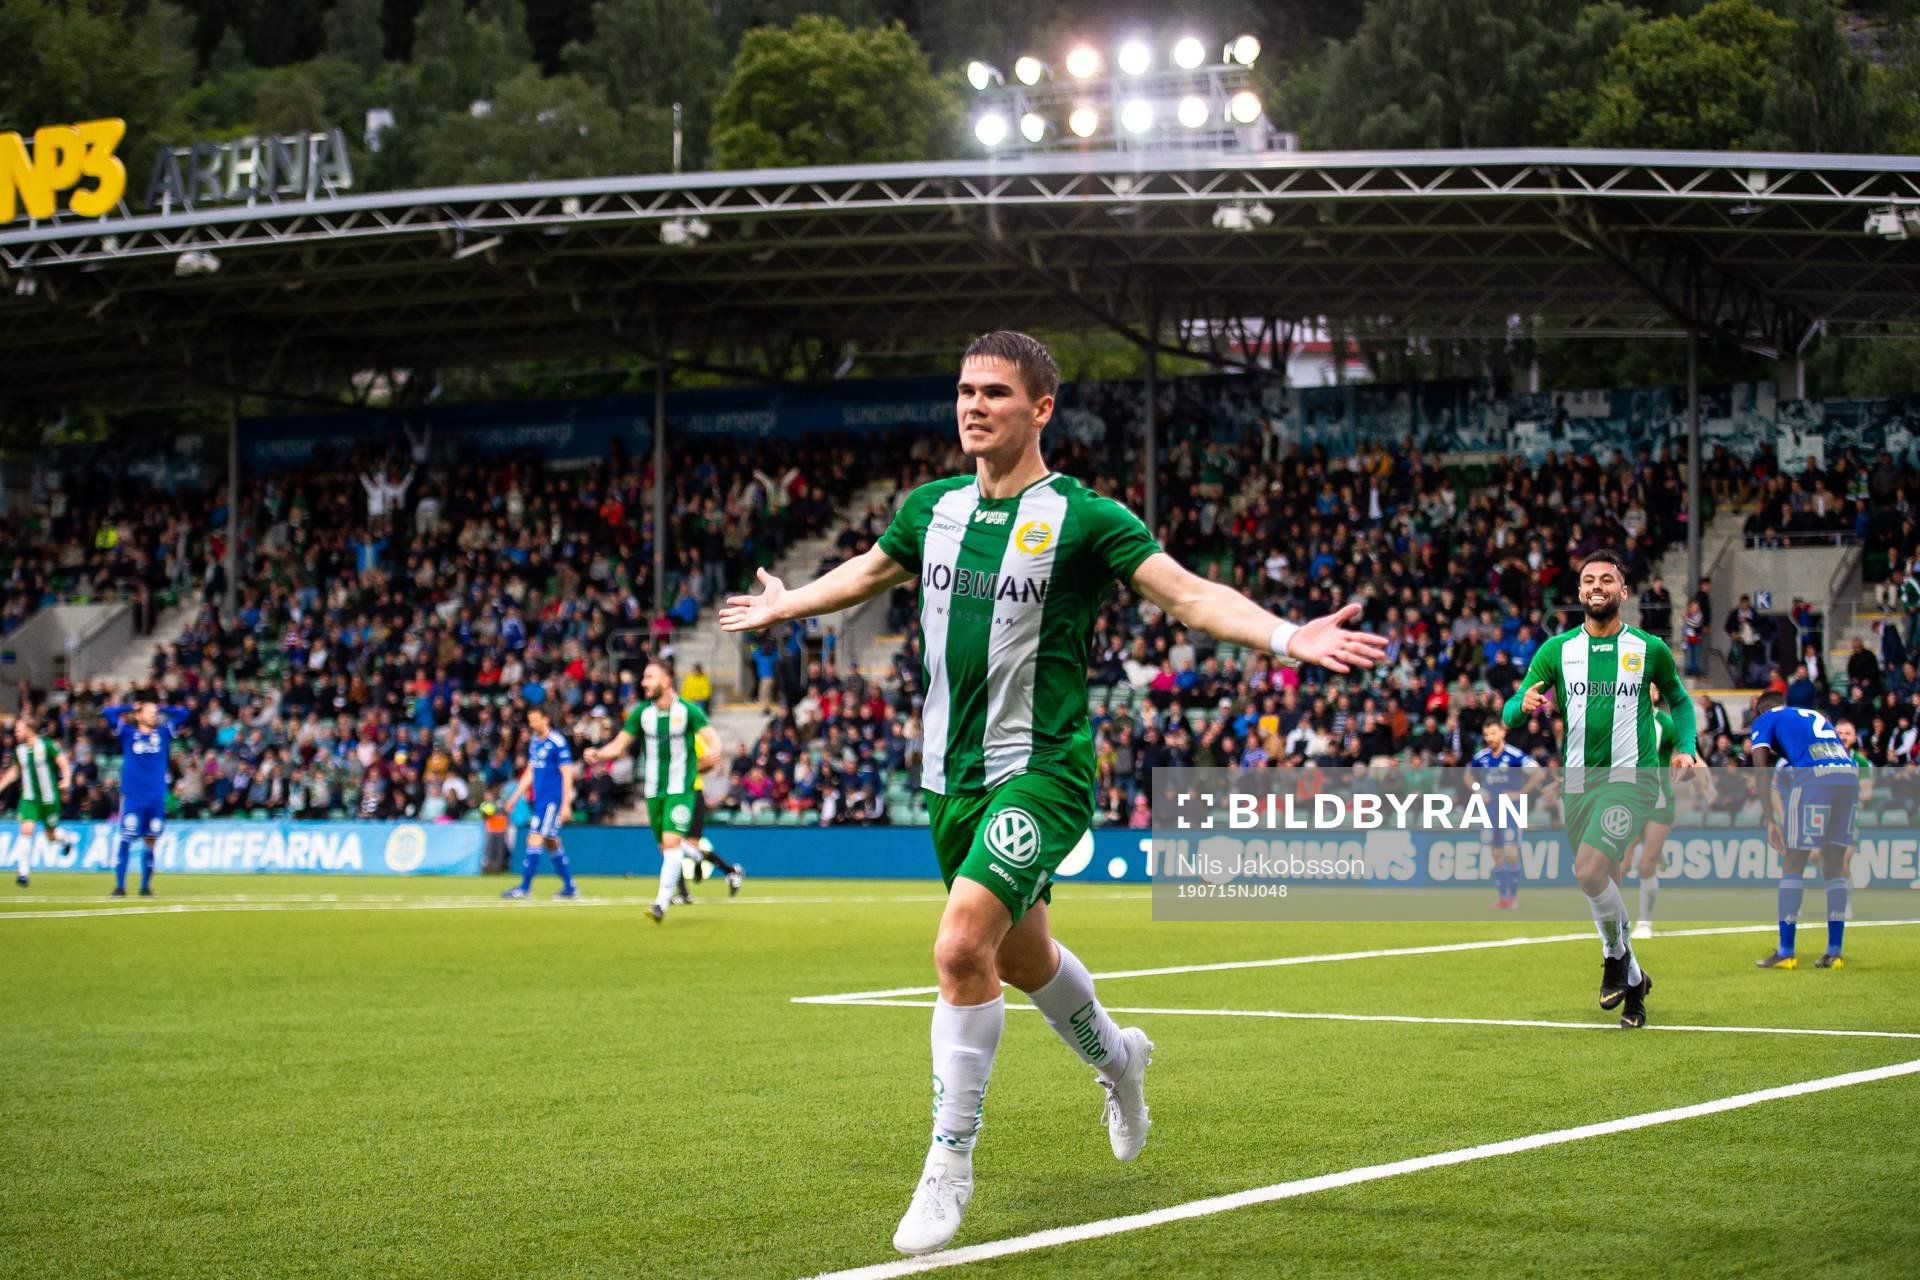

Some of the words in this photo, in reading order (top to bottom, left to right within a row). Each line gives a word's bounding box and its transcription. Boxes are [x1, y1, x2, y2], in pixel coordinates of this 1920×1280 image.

[0, 117, 127, 224] NP3
[923, 563, 1049, 604] JOBMAN
[1756, 591, 1771, 609] K
[1567, 682, 1642, 697] JOBMAN
[1797, 708, 1837, 739] 2
[183, 830, 363, 870] GIFFARNA
[1520, 840, 1560, 880] VI
[989, 863, 1015, 886] CRAFT
[1069, 1000, 1108, 1064] Clinton
